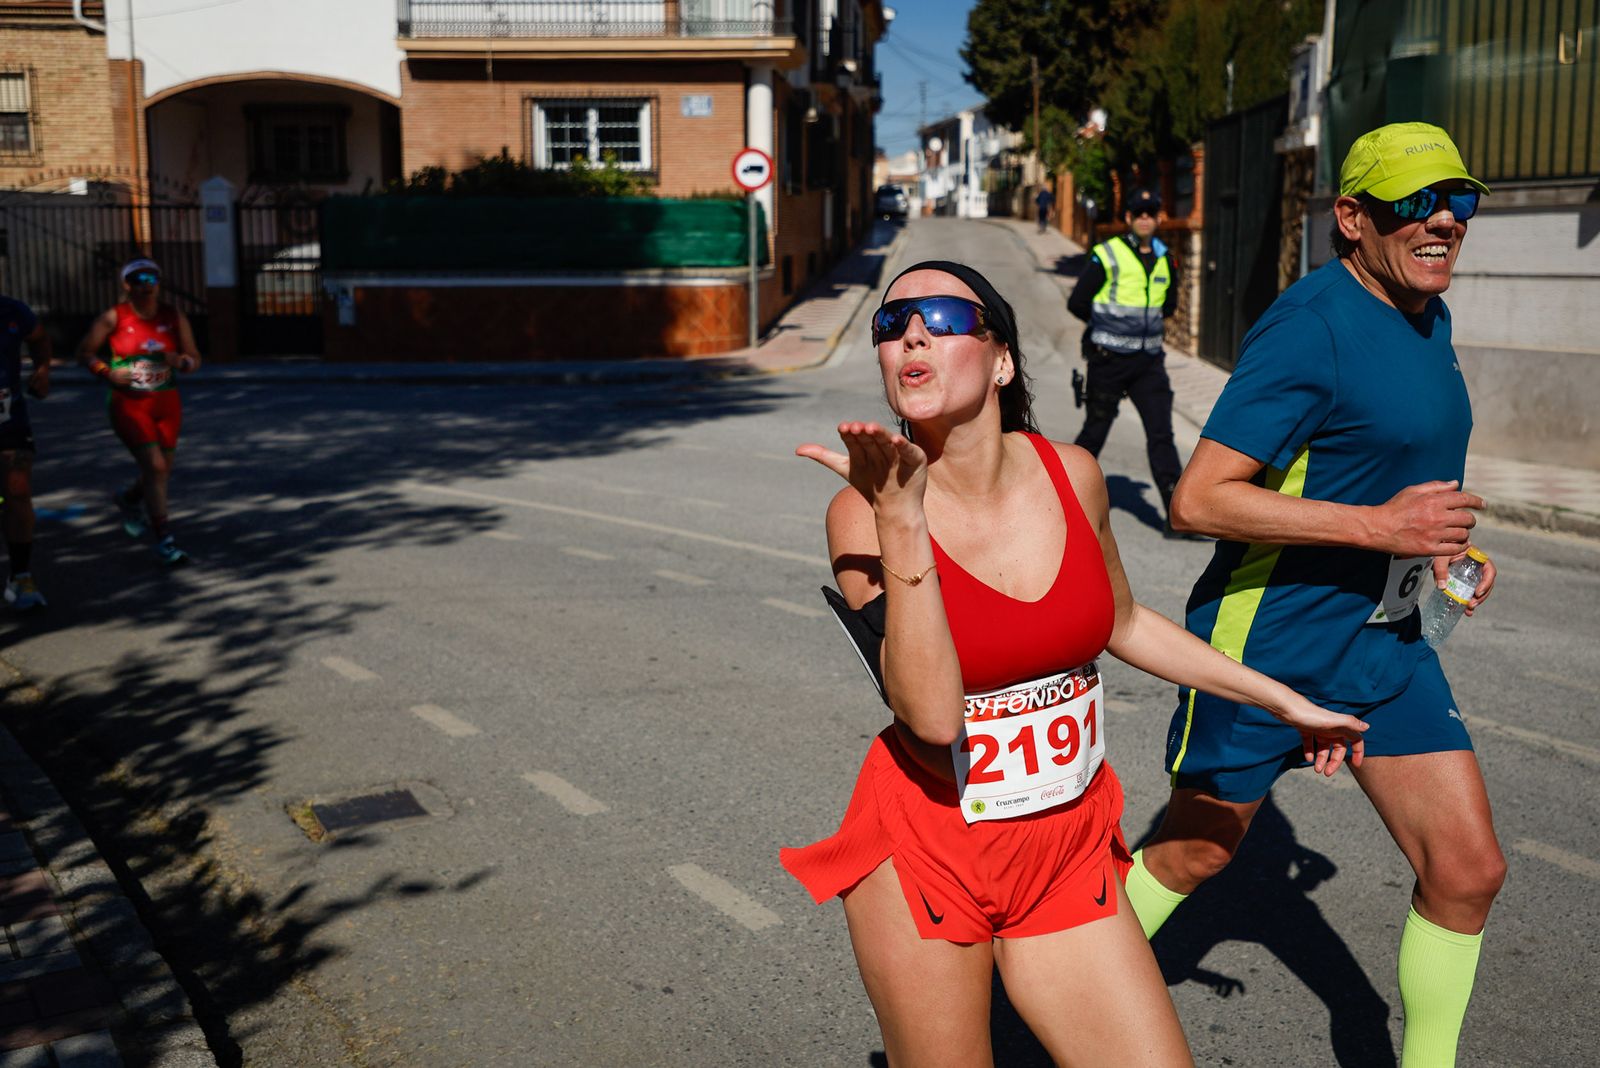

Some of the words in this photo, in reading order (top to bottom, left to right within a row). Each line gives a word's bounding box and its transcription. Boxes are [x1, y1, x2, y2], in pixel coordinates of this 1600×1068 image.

[991, 678, 1075, 717] FONDO
[960, 699, 1097, 785] 2191
[995, 795, 1030, 808] Cruzcampo
